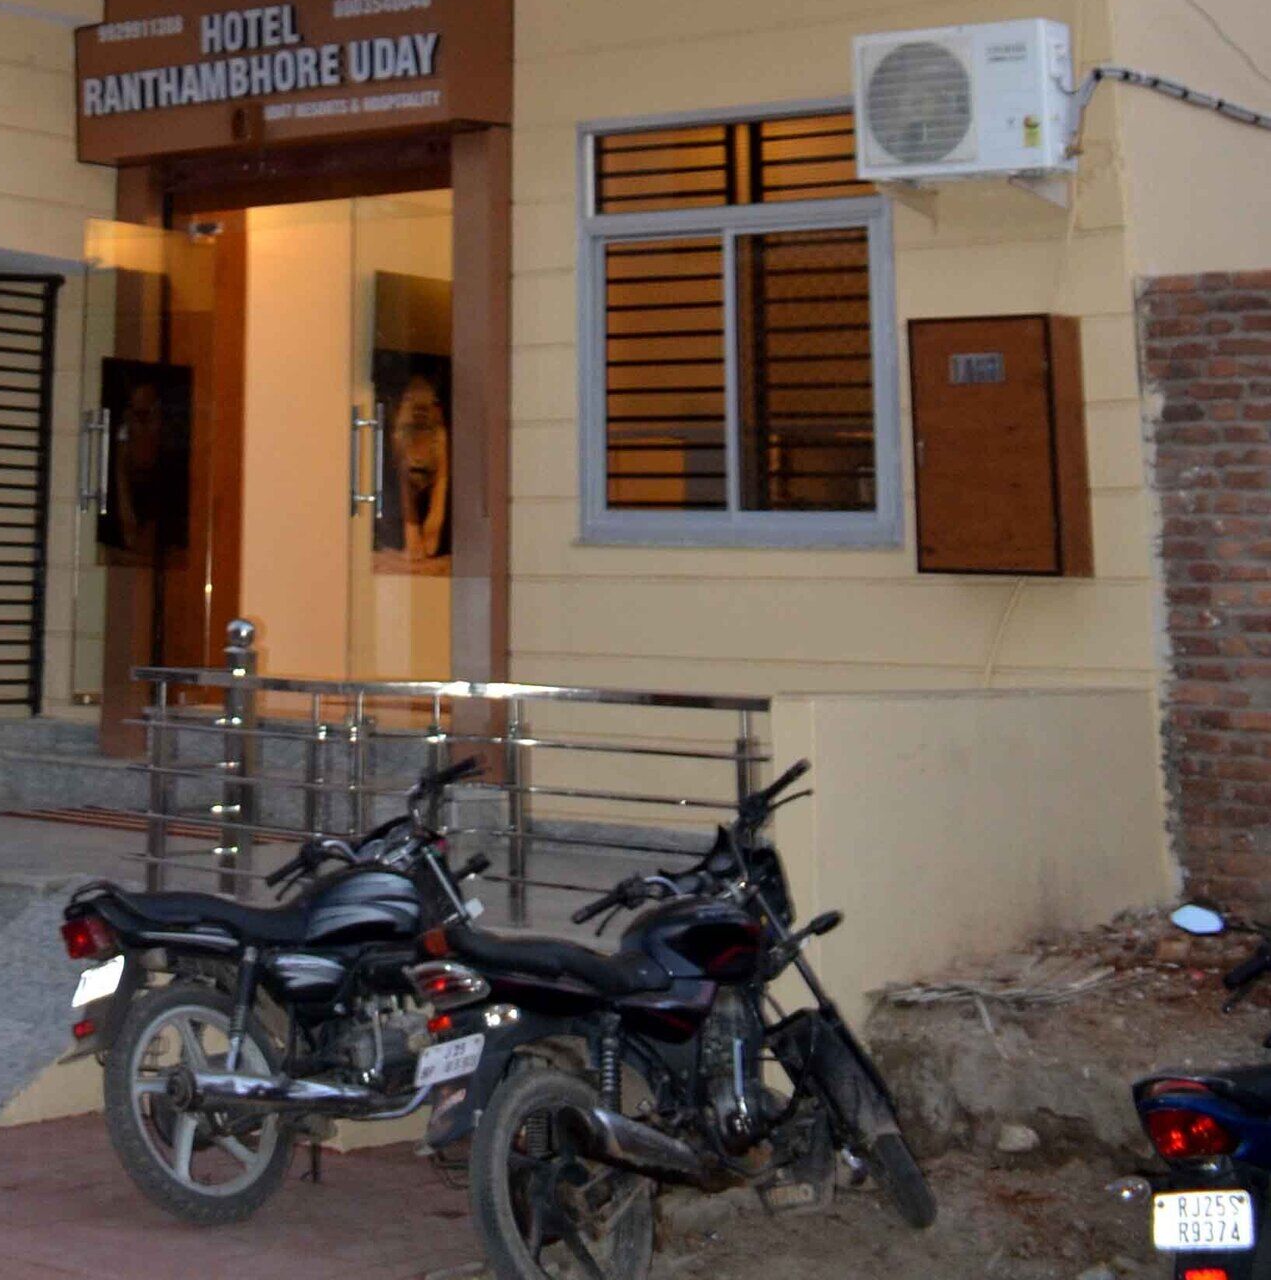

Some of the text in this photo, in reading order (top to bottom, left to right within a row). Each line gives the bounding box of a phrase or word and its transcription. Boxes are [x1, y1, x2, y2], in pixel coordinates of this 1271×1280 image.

[200, 5, 301, 54] HOTEL
[83, 33, 441, 118] RANTHAMBHORE UDAY
[1177, 1220, 1241, 1244] R9374
